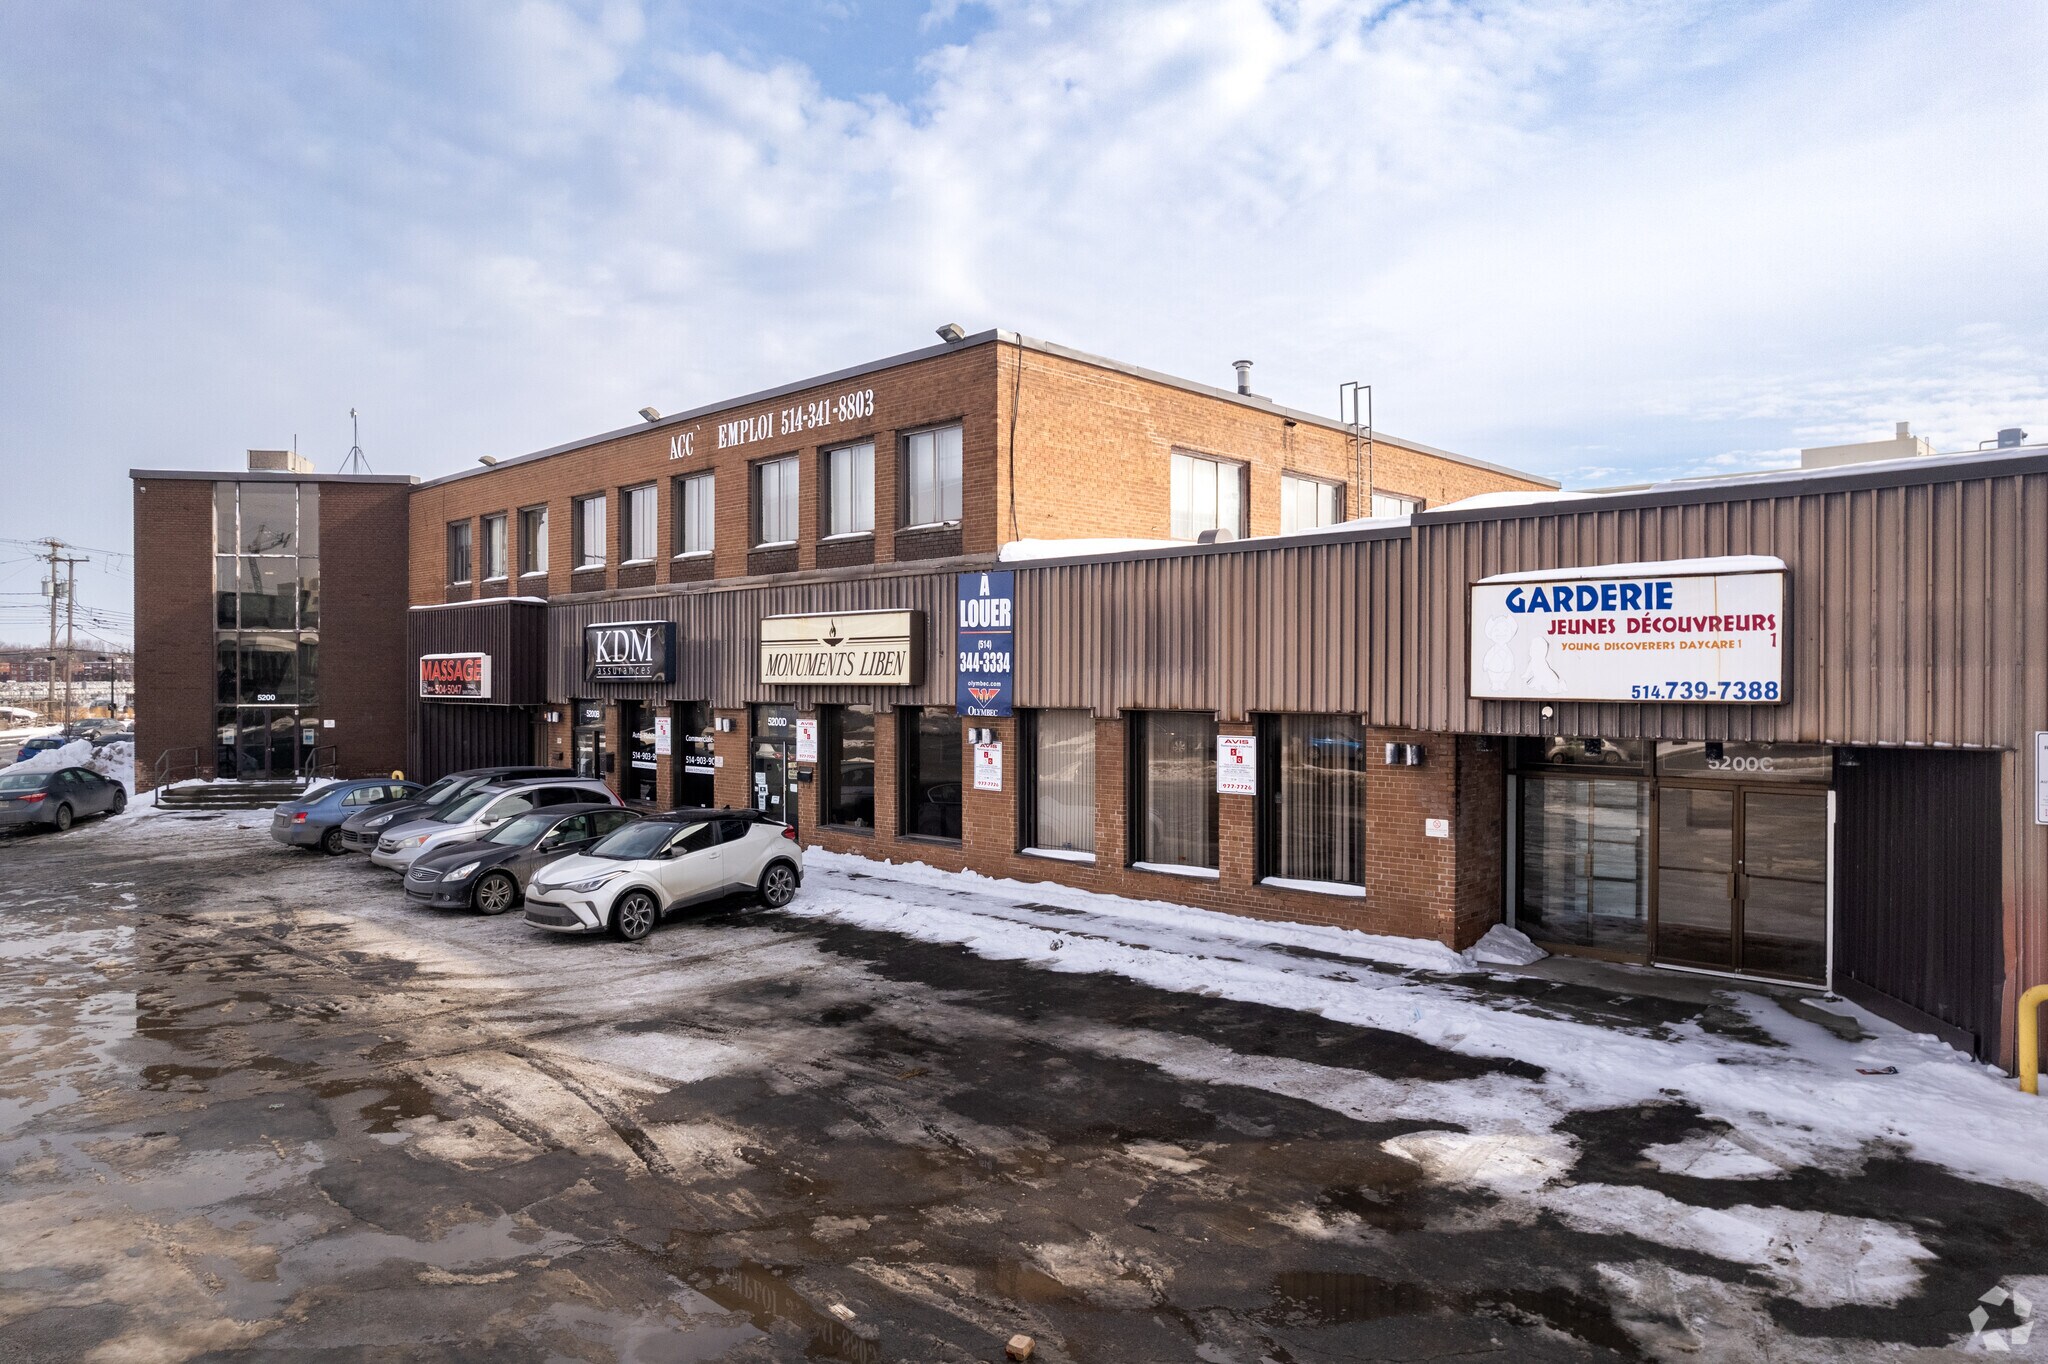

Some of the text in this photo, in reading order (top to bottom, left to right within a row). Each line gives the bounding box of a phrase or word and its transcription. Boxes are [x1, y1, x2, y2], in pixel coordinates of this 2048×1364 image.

[718, 412, 774, 449] EMPLOI
[781, 388, 874, 436] 514-341-8803
[1505, 581, 1673, 613] GARDERIE
[960, 598, 1011, 628] LOUER
[1547, 612, 1777, 635] JEUNES DÉCOUVREURS
[595, 628, 653, 663] KDM
[978, 639, 992, 650] (514)
[1561, 642, 1600, 651] YOUNG
[1604, 641, 1676, 650] DISCOVERERS
[1679, 640, 1735, 650] DAYCARE
[421, 659, 481, 681] MASSAGE
[597, 666, 651, 675] assurances
[765, 651, 906, 677] MONUMENTS LIBEN
[960, 652, 1010, 673] 344-3334
[1631, 681, 1779, 700] 514.739-7388
[767, 717, 787, 727] 5200D
[967, 706, 998, 717] OLYMBEC
[1708, 755, 1774, 772] 5200C
